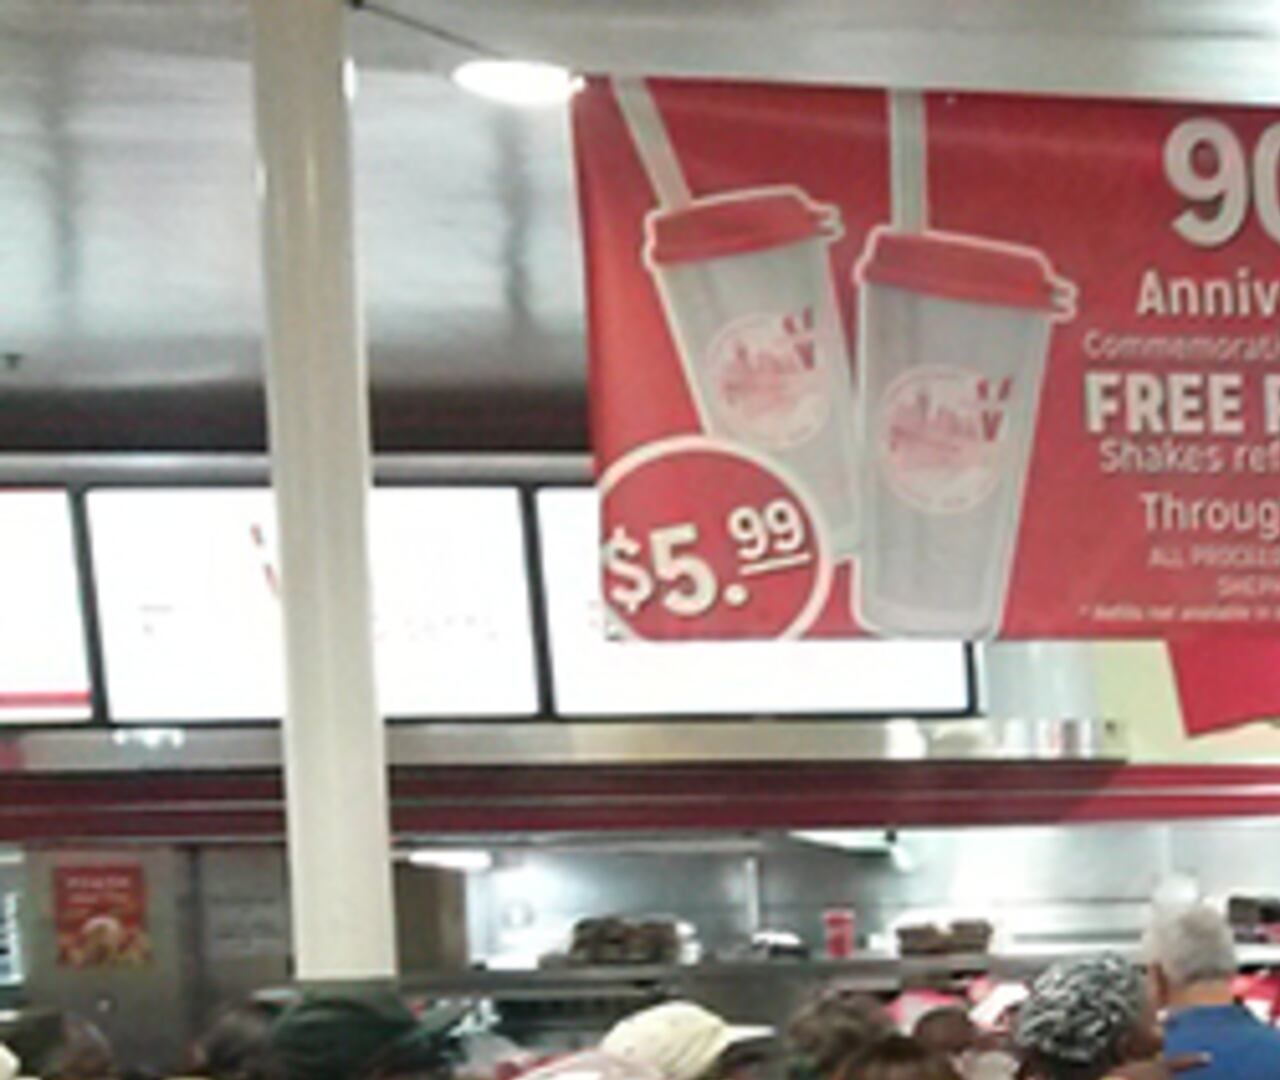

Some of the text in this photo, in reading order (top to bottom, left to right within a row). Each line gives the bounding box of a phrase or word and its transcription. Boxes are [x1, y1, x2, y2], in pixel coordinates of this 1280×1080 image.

[1083, 371, 1245, 436] FREE
[1100, 438, 1223, 474] Shakes
[602, 499, 807, 617] $5.99
